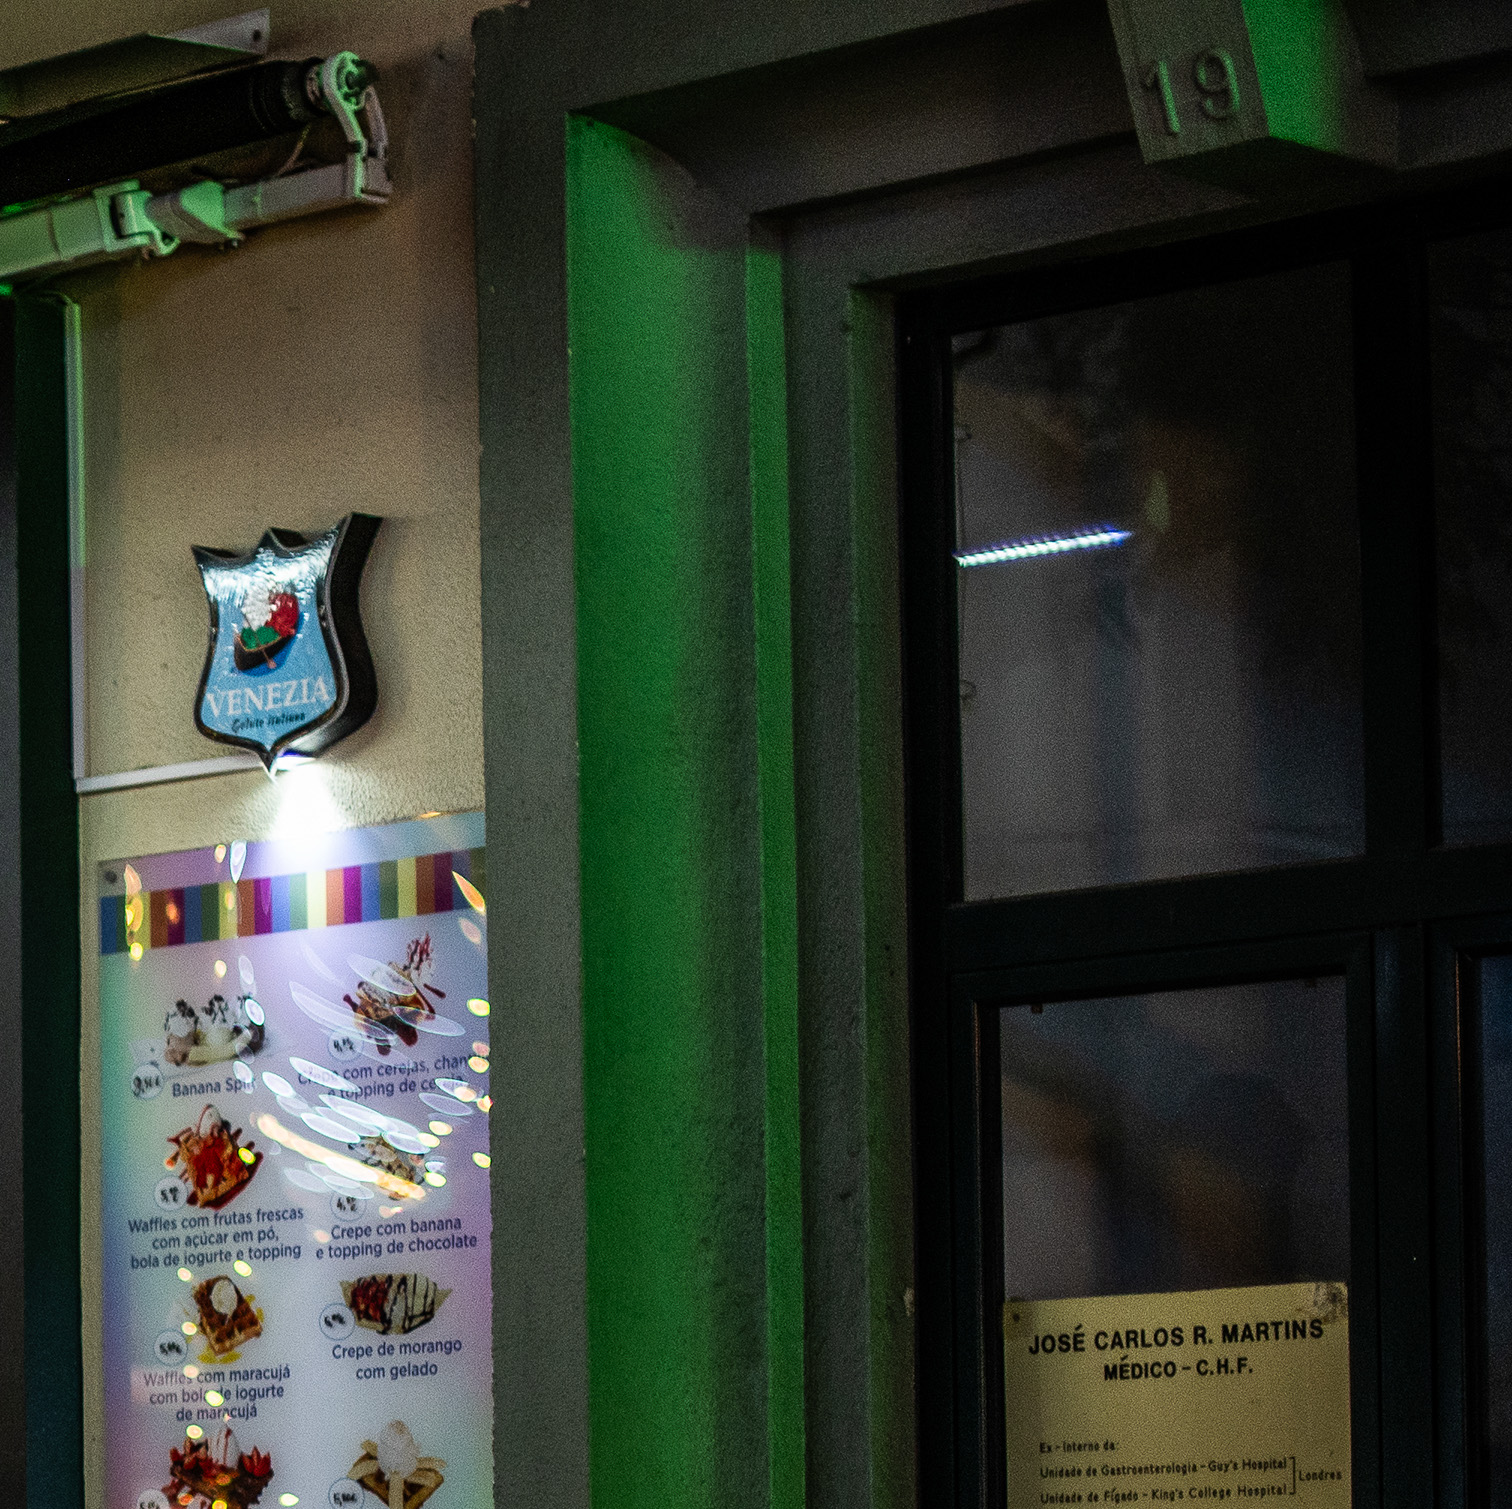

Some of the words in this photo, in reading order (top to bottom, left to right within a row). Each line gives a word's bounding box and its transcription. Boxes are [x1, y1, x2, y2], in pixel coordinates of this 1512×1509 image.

[1140, 48, 1241, 137] 19
[206, 676, 330, 717] VENEZIA
[344, 1066, 373, 1080] com
[172, 1081, 221, 1098] Banana
[399, 1079, 417, 1092] de
[128, 1216, 177, 1233] Waffles
[181, 1217, 210, 1230] com
[214, 1212, 252, 1226] frutas
[256, 1207, 304, 1222] frescas
[331, 1225, 372, 1240] Crepe
[376, 1222, 406, 1236] com
[410, 1217, 462, 1233] banana
[152, 1237, 180, 1250] com
[185, 1231, 228, 1248] açúcar
[233, 1230, 253, 1243] em
[257, 1226, 279, 1243] pó,
[315, 1248, 324, 1259] e
[328, 1242, 382, 1260] topping
[387, 1240, 404, 1253] de
[408, 1234, 478, 1252] chocolate
[131, 1255, 159, 1270] bola
[163, 1253, 180, 1266] de
[184, 1250, 232, 1267] iogurte
[236, 1249, 244, 1260] e
[248, 1244, 302, 1262] topping
[1028, 1324, 1085, 1355] JOSÉ
[1094, 1327, 1184, 1351] CARLOS
[1193, 1325, 1213, 1346] R.
[1221, 1319, 1324, 1345] MARTINS
[332, 1344, 373, 1360] Crepe
[377, 1342, 395, 1356] de
[399, 1339, 462, 1355] morango
[197, 1371, 225, 1383] com
[229, 1364, 291, 1382] maracujá
[356, 1366, 385, 1380] com
[390, 1362, 438, 1380] gelado
[1104, 1355, 1176, 1381] MÉDICO
[1196, 1357, 1253, 1377] C.H.F.
[149, 1392, 177, 1405] com
[182, 1389, 210, 1403] bol
[235, 1385, 284, 1401] iogurte
[176, 1408, 192, 1421] de
[1040, 1466, 1082, 1478] Unidade
[1086, 1466, 1097, 1477] de
[1101, 1462, 1197, 1477] Gastroenterologia
[1208, 1460, 1238, 1473] Guy's
[1242, 1457, 1287, 1472] Hospital
[1299, 1470, 1342, 1481] Londres
[1040, 1492, 1082, 1504] Unidade
[1087, 1491, 1099, 1502] de
[1151, 1488, 1184, 1501] King's
[1188, 1487, 1231, 1499] College
[1237, 1483, 1287, 1498] Hospital
